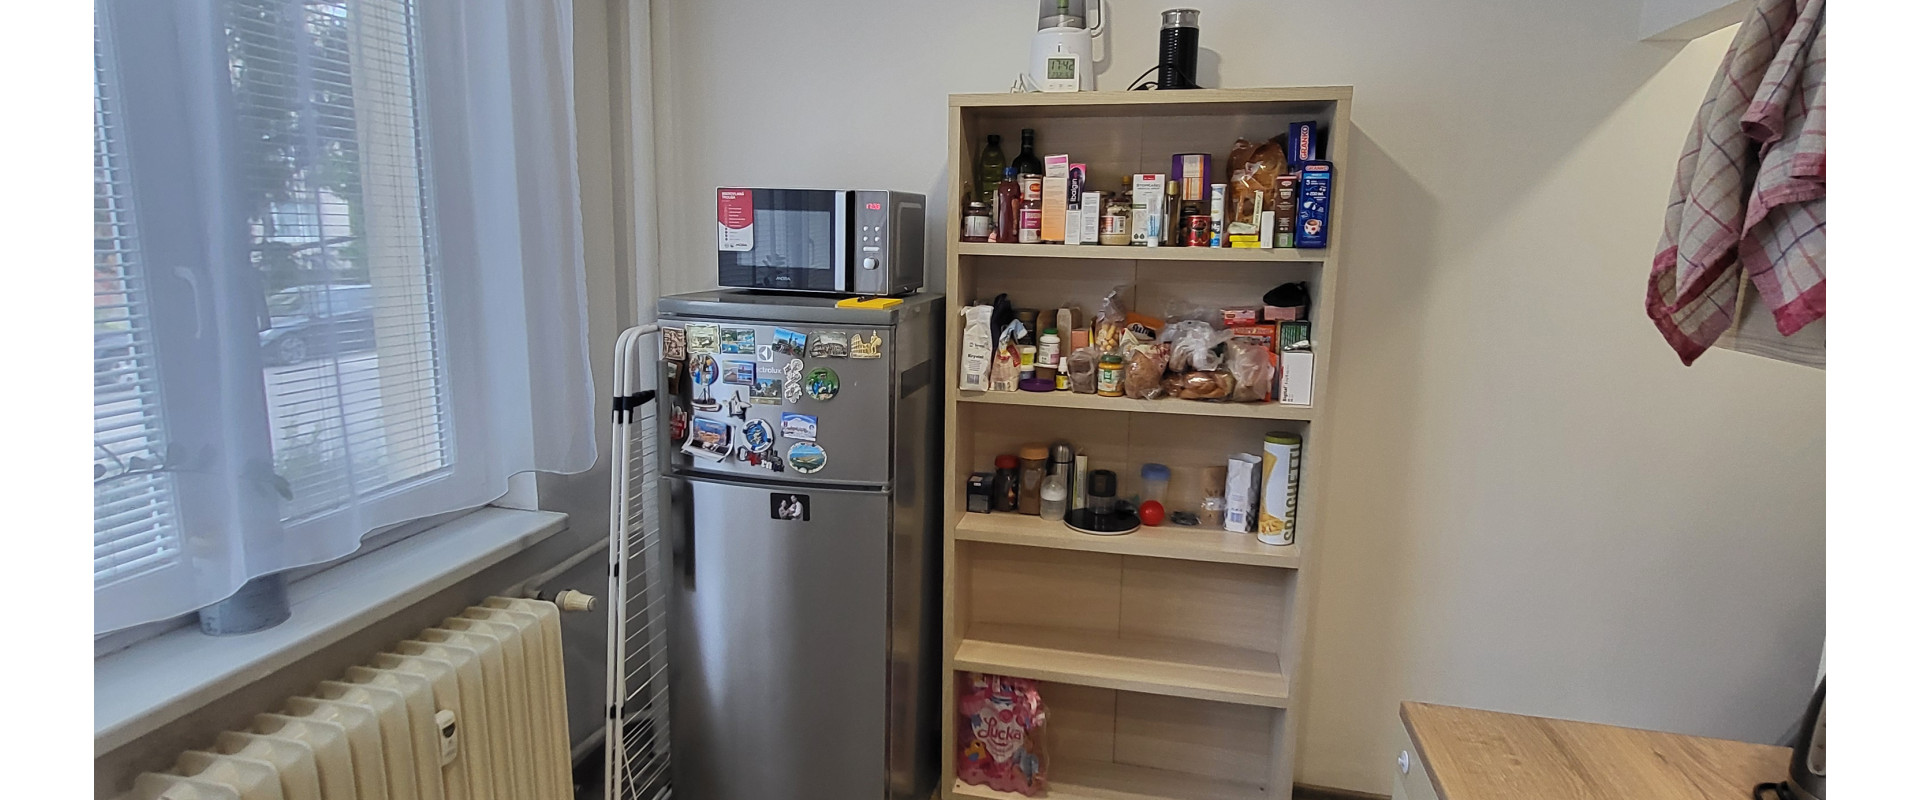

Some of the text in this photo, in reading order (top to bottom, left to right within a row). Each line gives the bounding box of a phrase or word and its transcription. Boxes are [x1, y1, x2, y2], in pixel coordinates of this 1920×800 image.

[1300, 126, 1309, 159] GRANKO
[1070, 178, 1078, 202] Ibalgin
[978, 717, 1022, 740] Lucka
